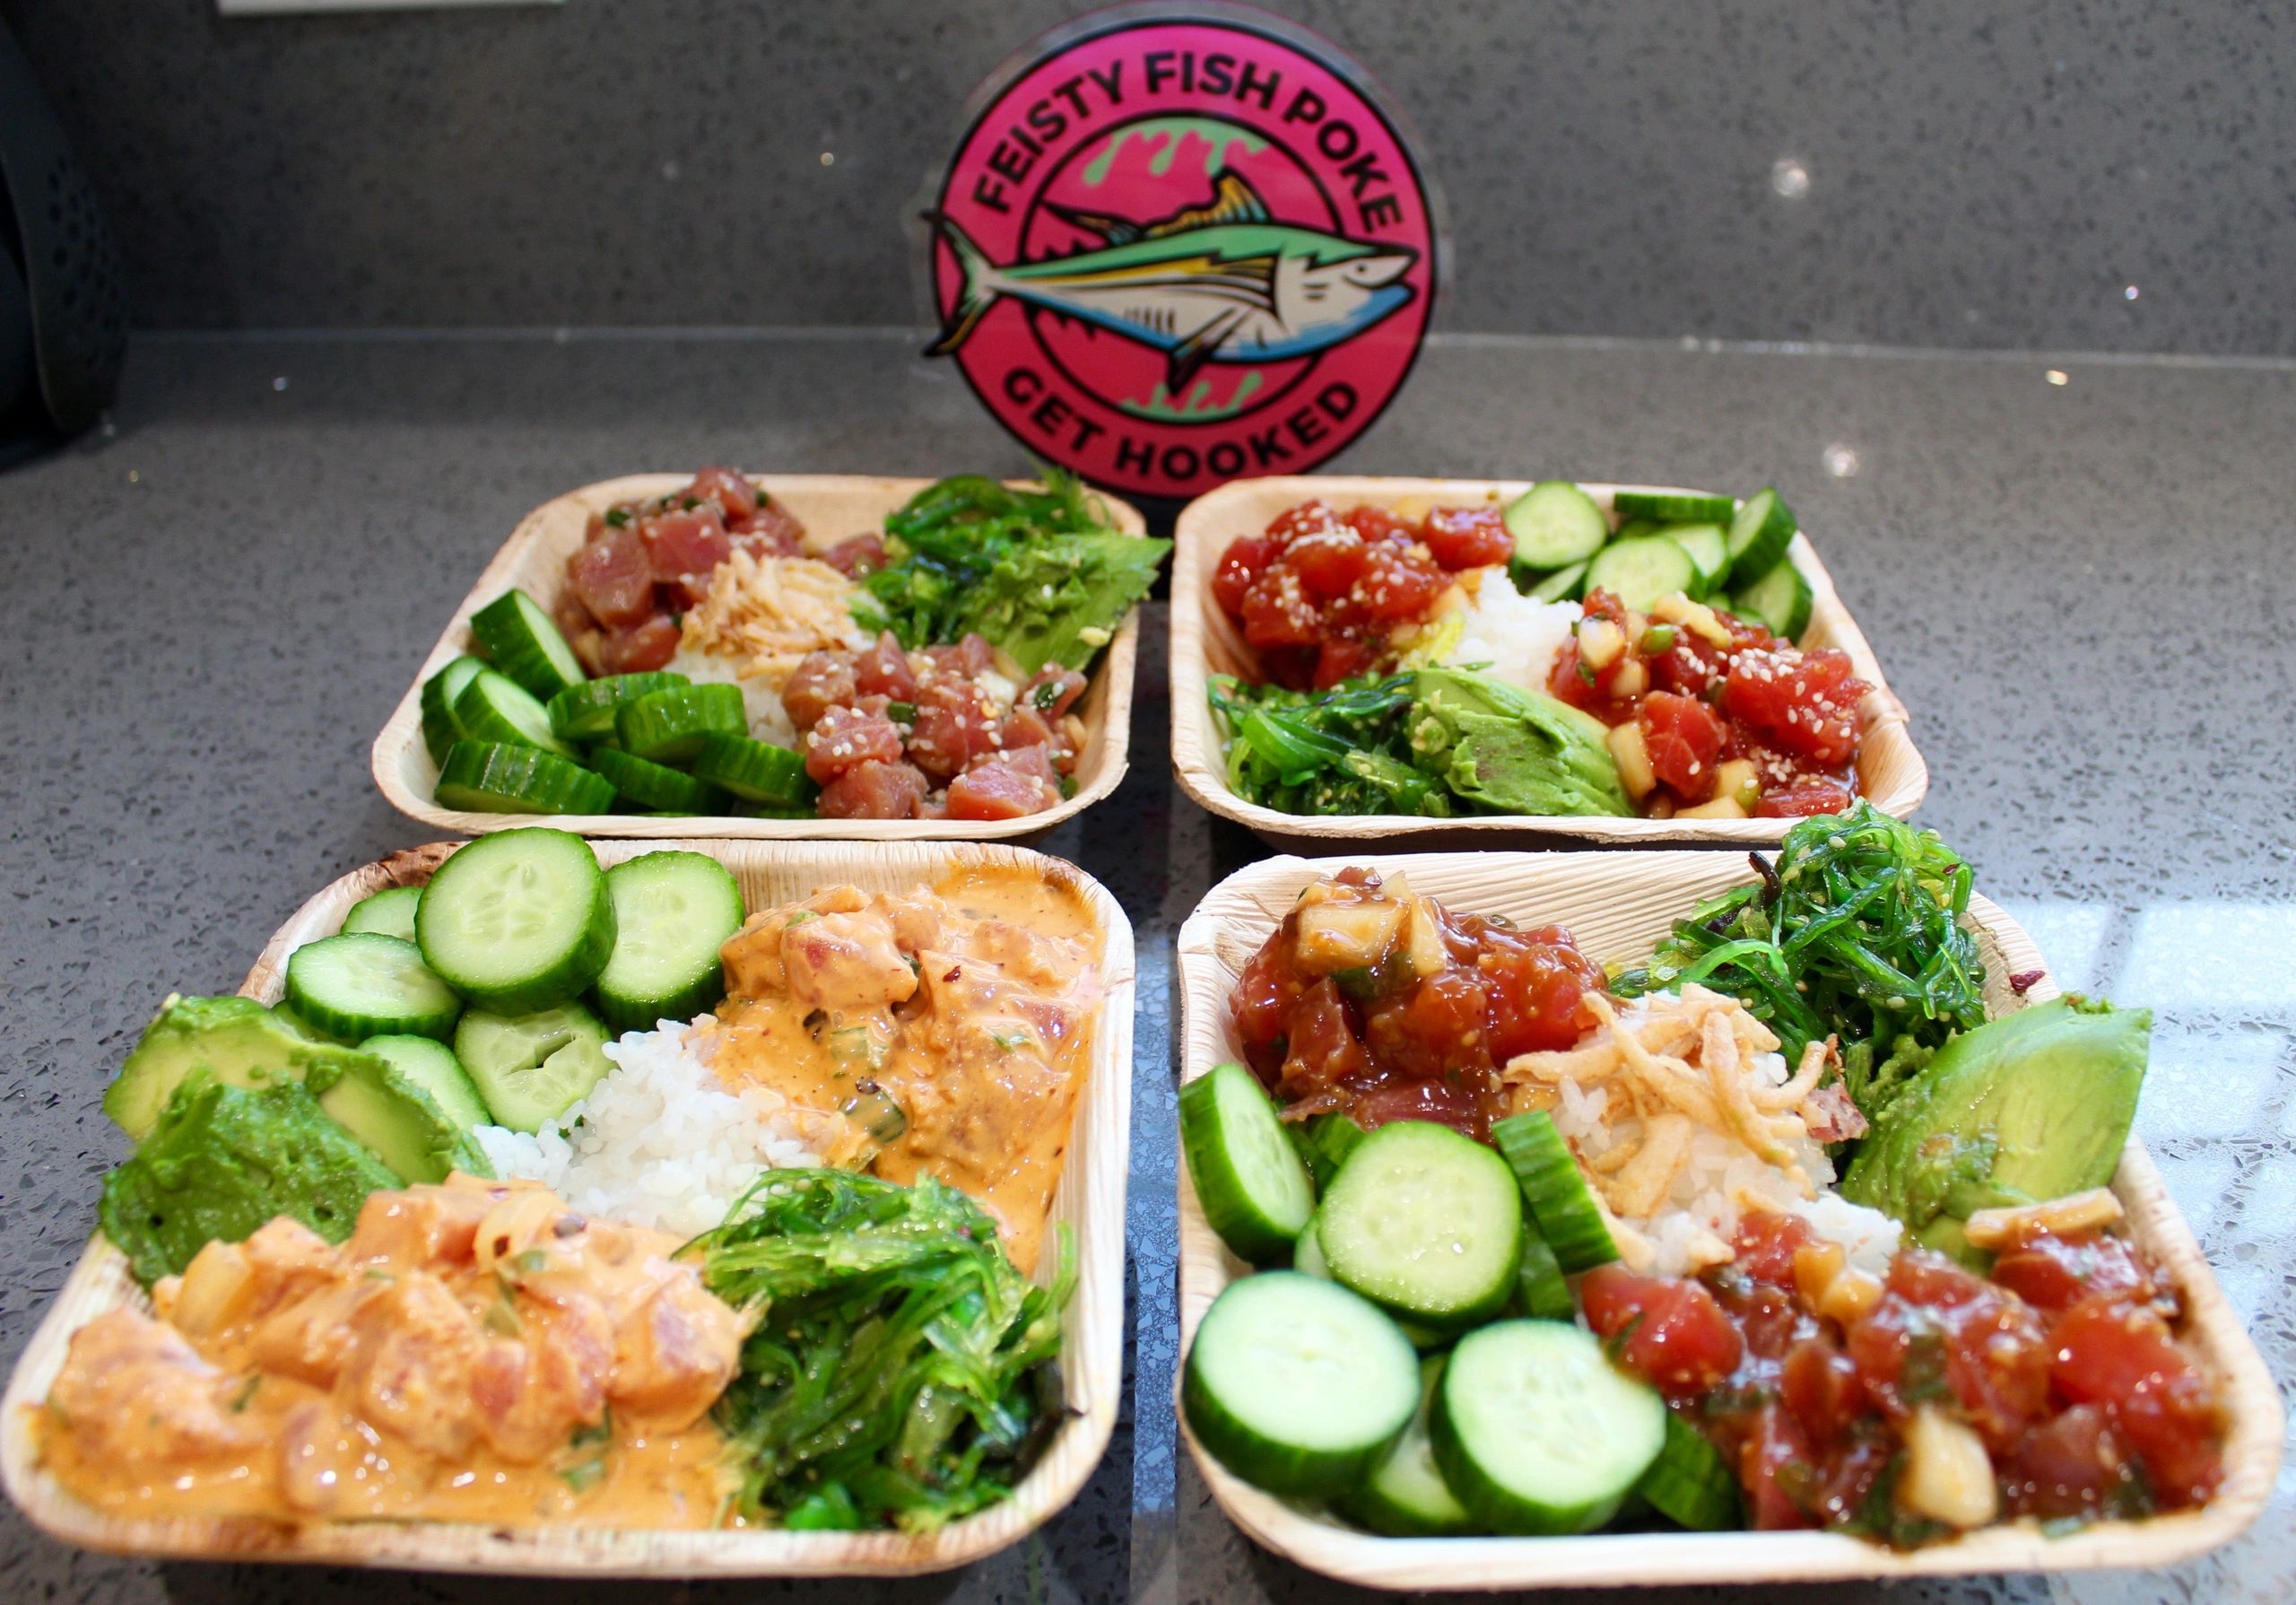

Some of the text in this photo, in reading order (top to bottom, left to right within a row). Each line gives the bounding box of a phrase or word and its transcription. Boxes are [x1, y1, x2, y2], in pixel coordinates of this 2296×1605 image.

[972, 51, 1404, 233] FEISTY FISH POKE
[1003, 367, 1359, 481] GET HOOKED
